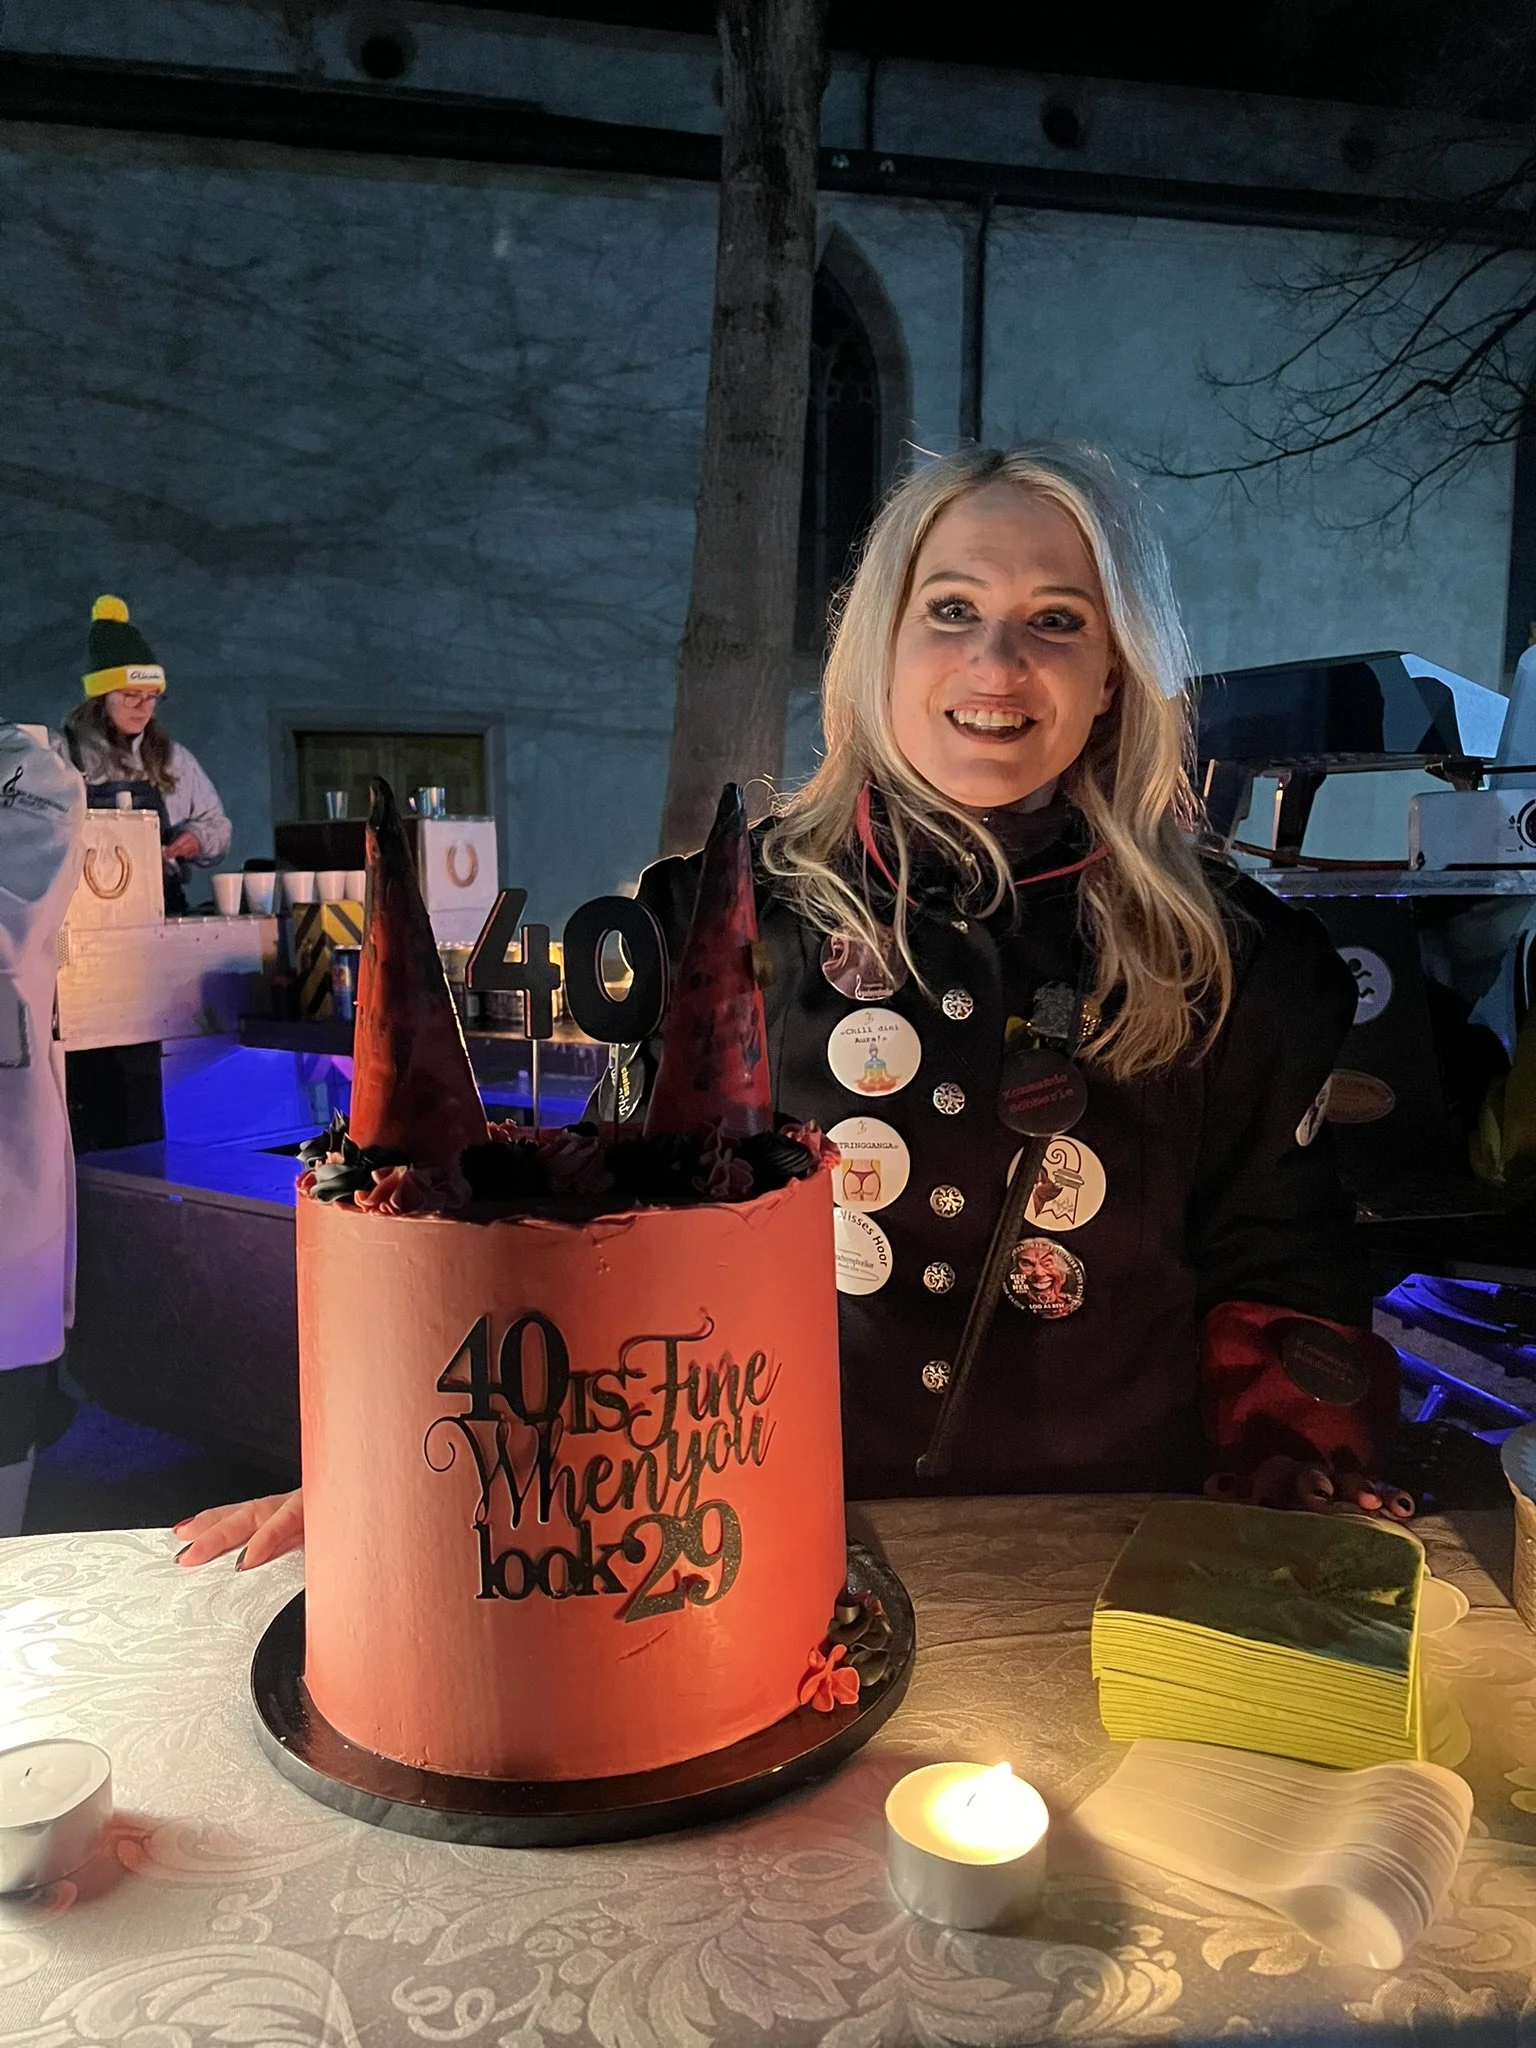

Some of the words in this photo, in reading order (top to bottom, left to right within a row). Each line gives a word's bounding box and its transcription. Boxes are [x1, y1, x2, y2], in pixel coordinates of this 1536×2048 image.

[464, 887, 671, 1044] 40
[872, 1235, 888, 1268] Hoor
[437, 1311, 570, 1423] 40
[619, 1315, 782, 1451] Fine
[424, 1410, 671, 1528] When
[664, 1410, 777, 1519] you
[472, 1520, 628, 1601] look
[621, 1498, 743, 1624] 29
